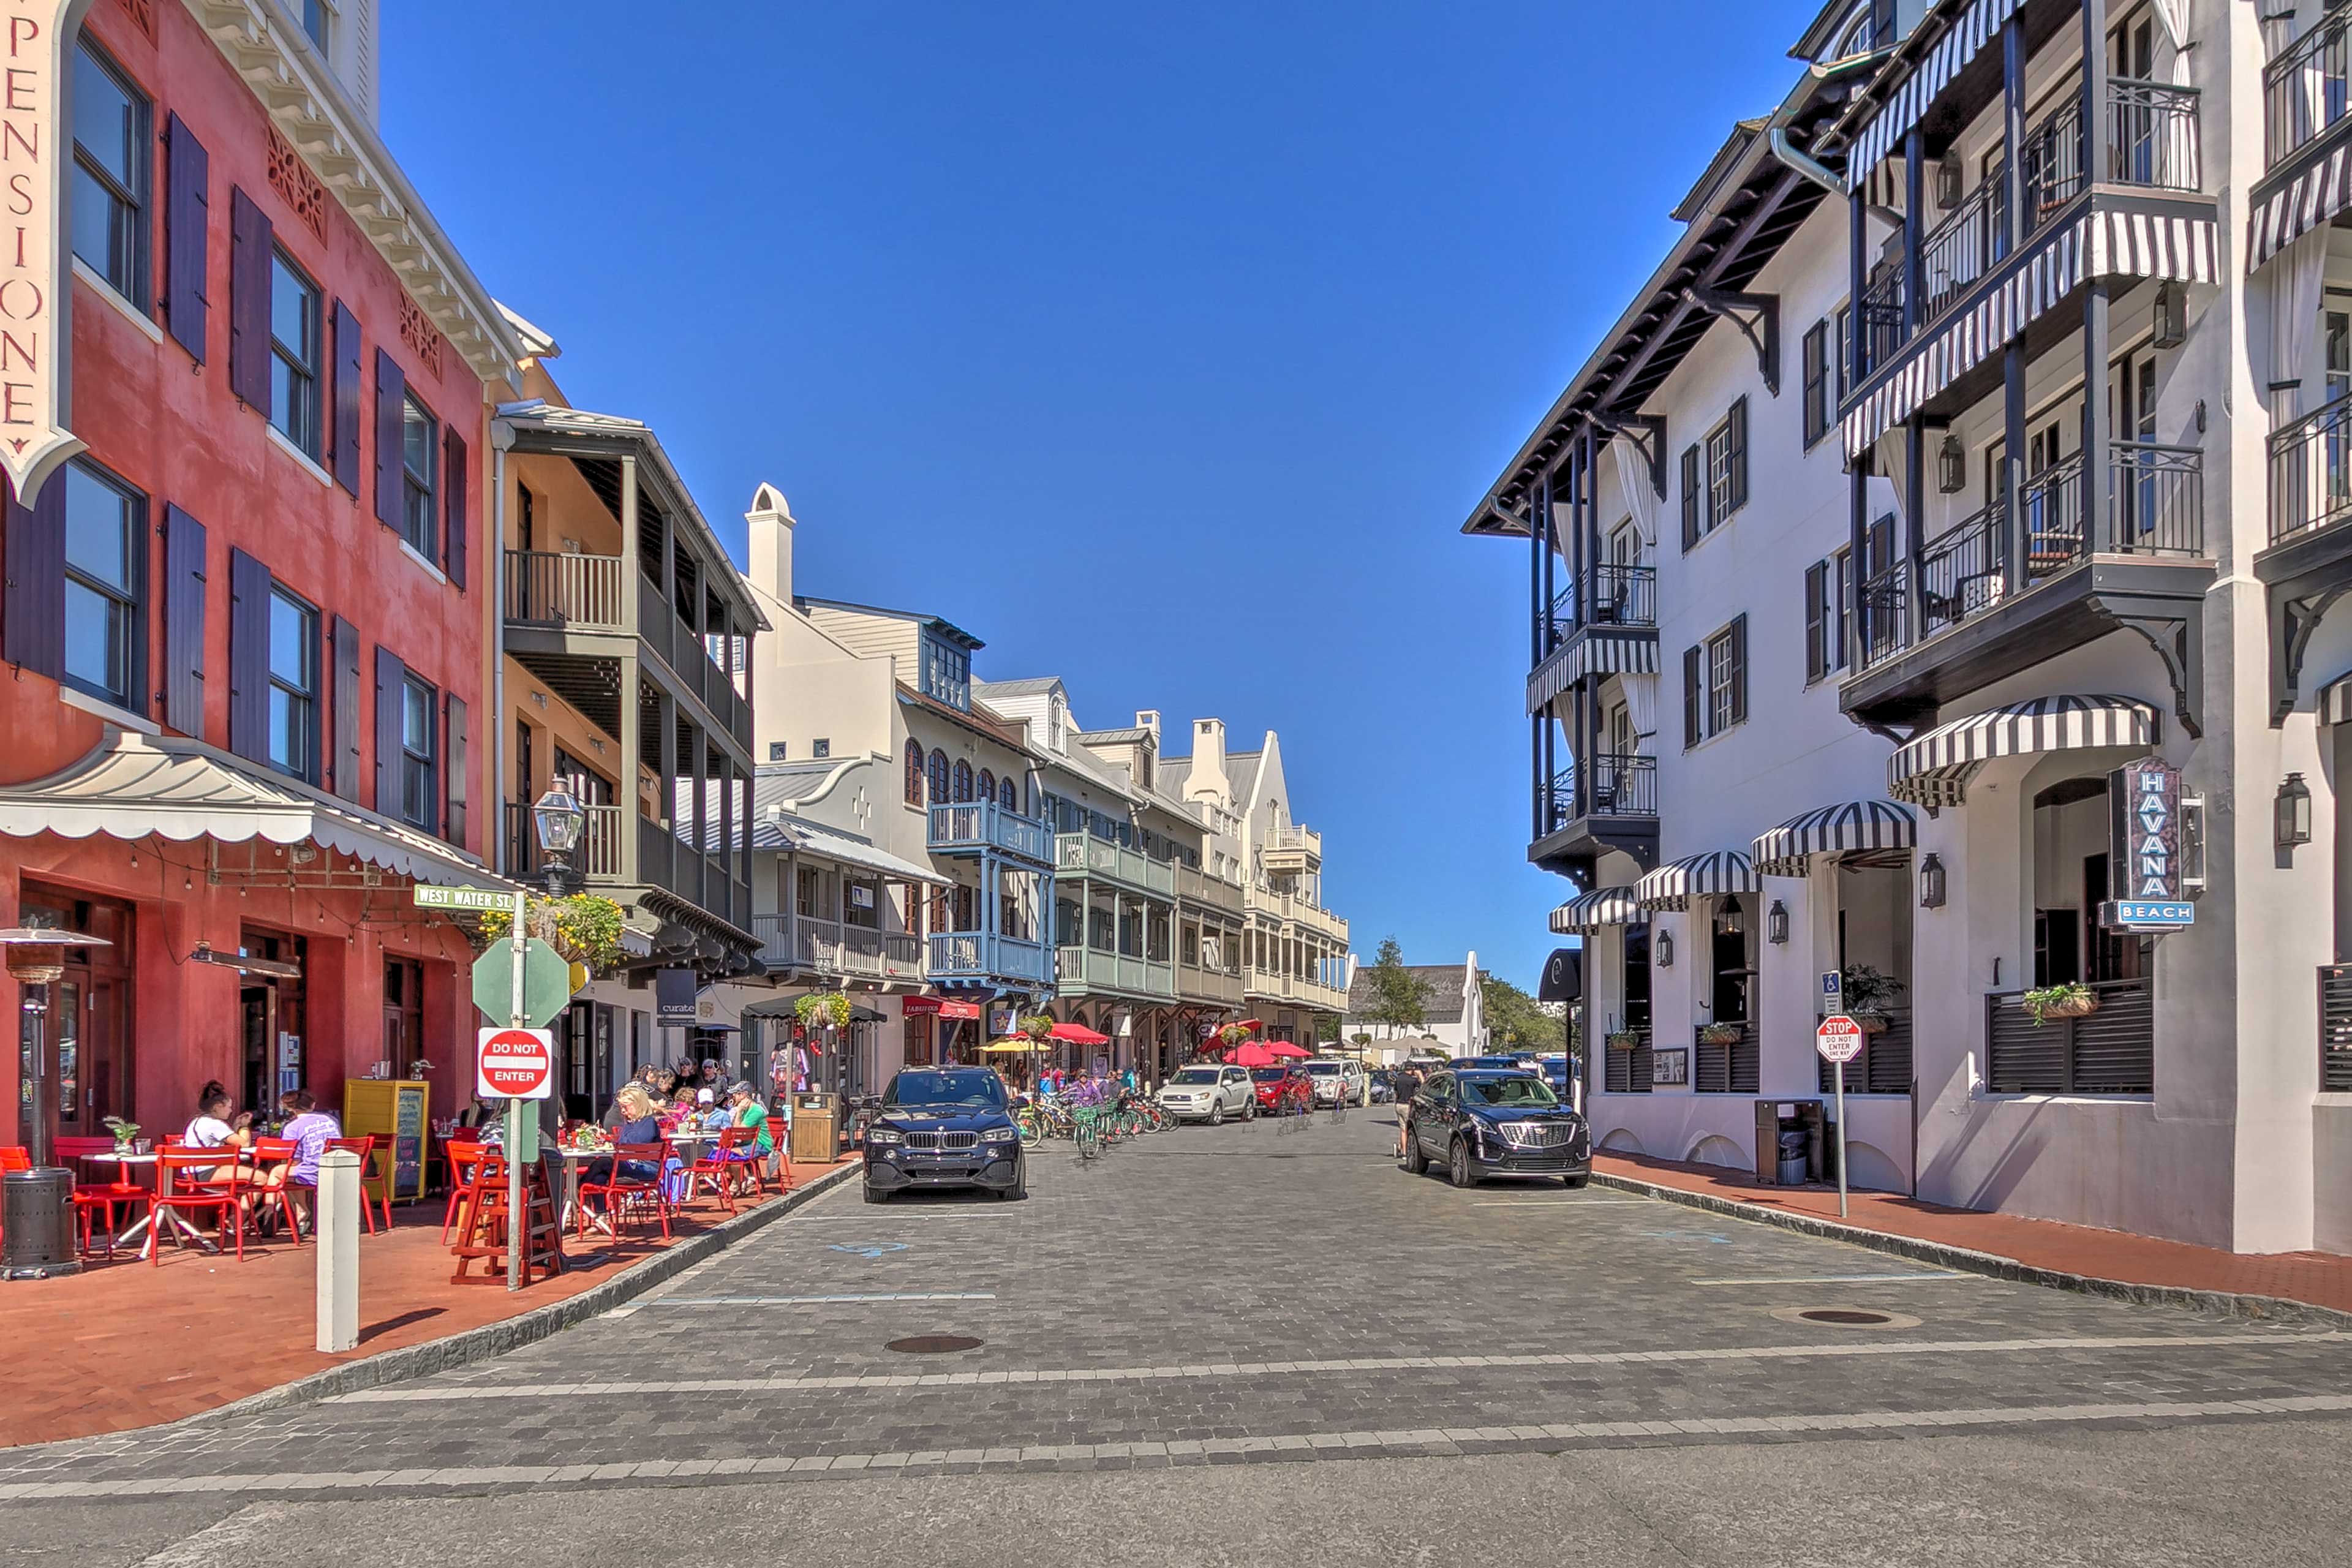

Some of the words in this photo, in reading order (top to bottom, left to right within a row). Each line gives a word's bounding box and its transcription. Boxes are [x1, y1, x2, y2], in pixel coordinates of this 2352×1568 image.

[1, 16, 42, 425] PENSIONE
[2138, 772, 2169, 896] HAVANA
[419, 888, 449, 903] WEST
[454, 891, 492, 907] WATER
[2122, 907, 2190, 918] BEACH
[1826, 1022, 1852, 1034] STOP
[492, 1043, 510, 1053] DO
[513, 1044, 538, 1054] NOT
[495, 1071, 535, 1081] ENTER
